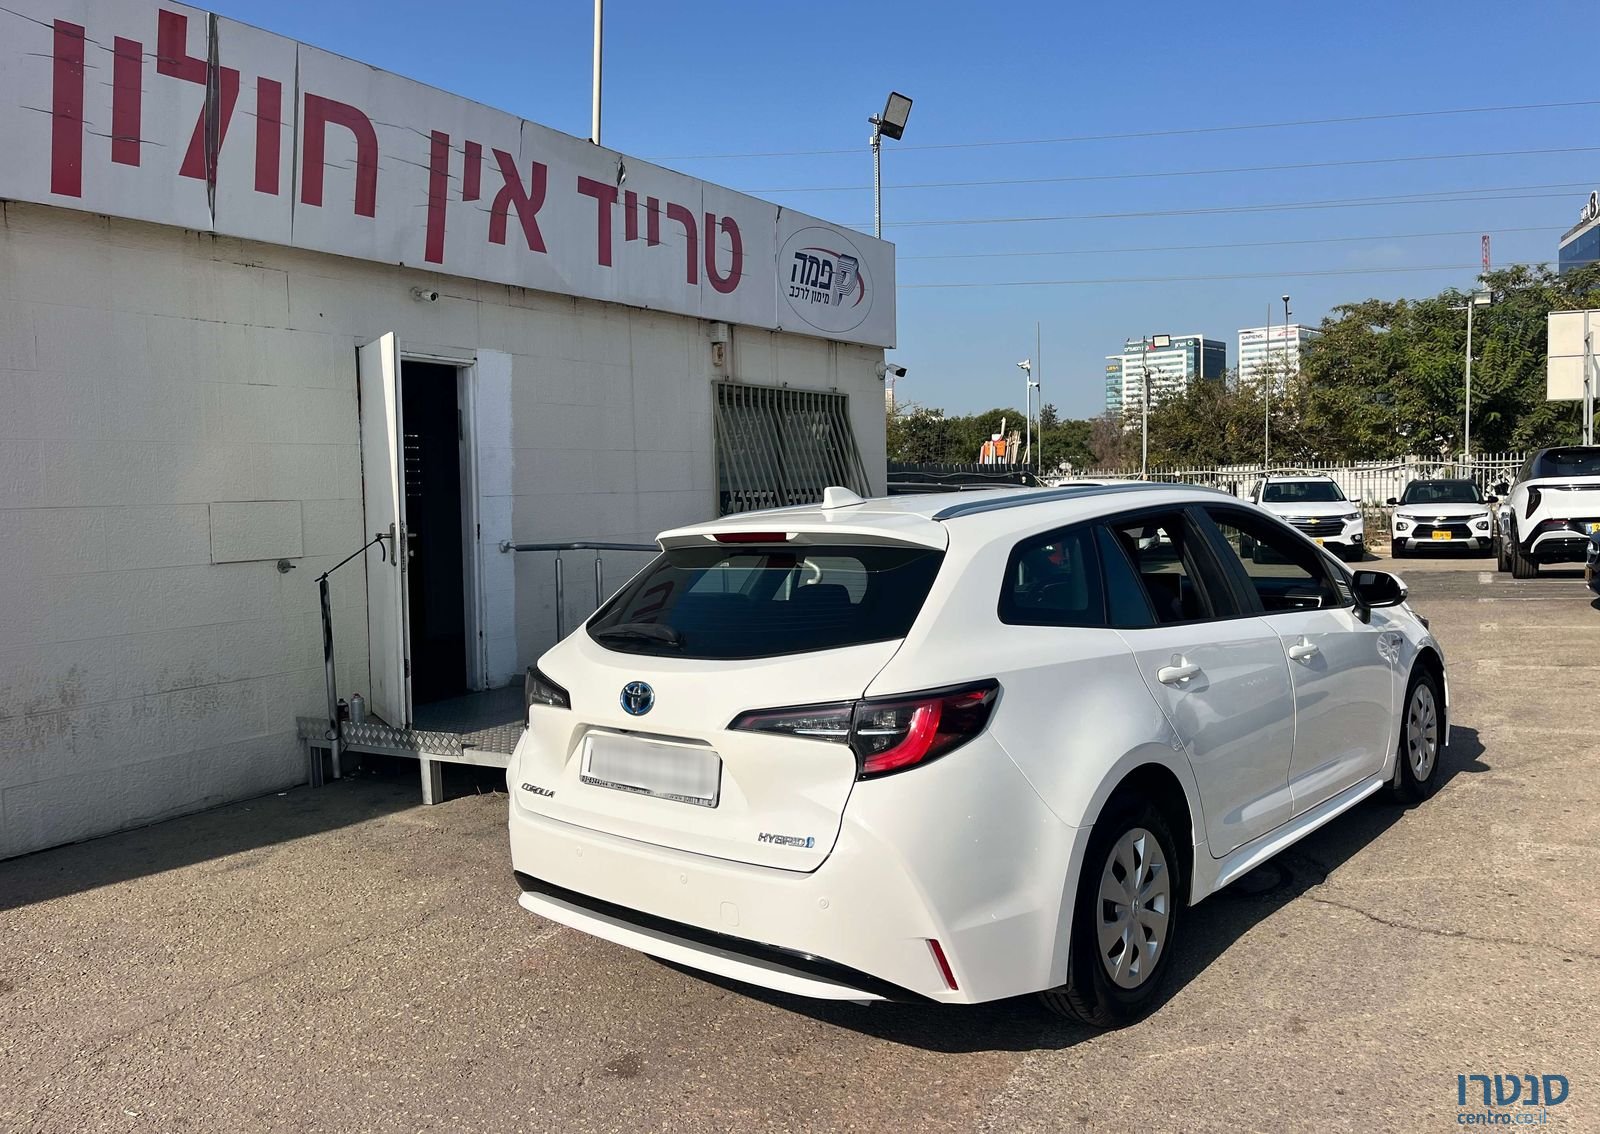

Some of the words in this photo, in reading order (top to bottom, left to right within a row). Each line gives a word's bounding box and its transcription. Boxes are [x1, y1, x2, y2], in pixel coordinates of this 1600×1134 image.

[50, 8, 379, 218] חולון
[425, 129, 547, 264] אין
[577, 175, 743, 294] טרייד
[791, 251, 833, 290] פמה
[789, 285, 810, 300] לרכב
[811, 290, 830, 305] מימון
[521, 782, 555, 798] COROLLA
[758, 832, 805, 847] HYBRID
